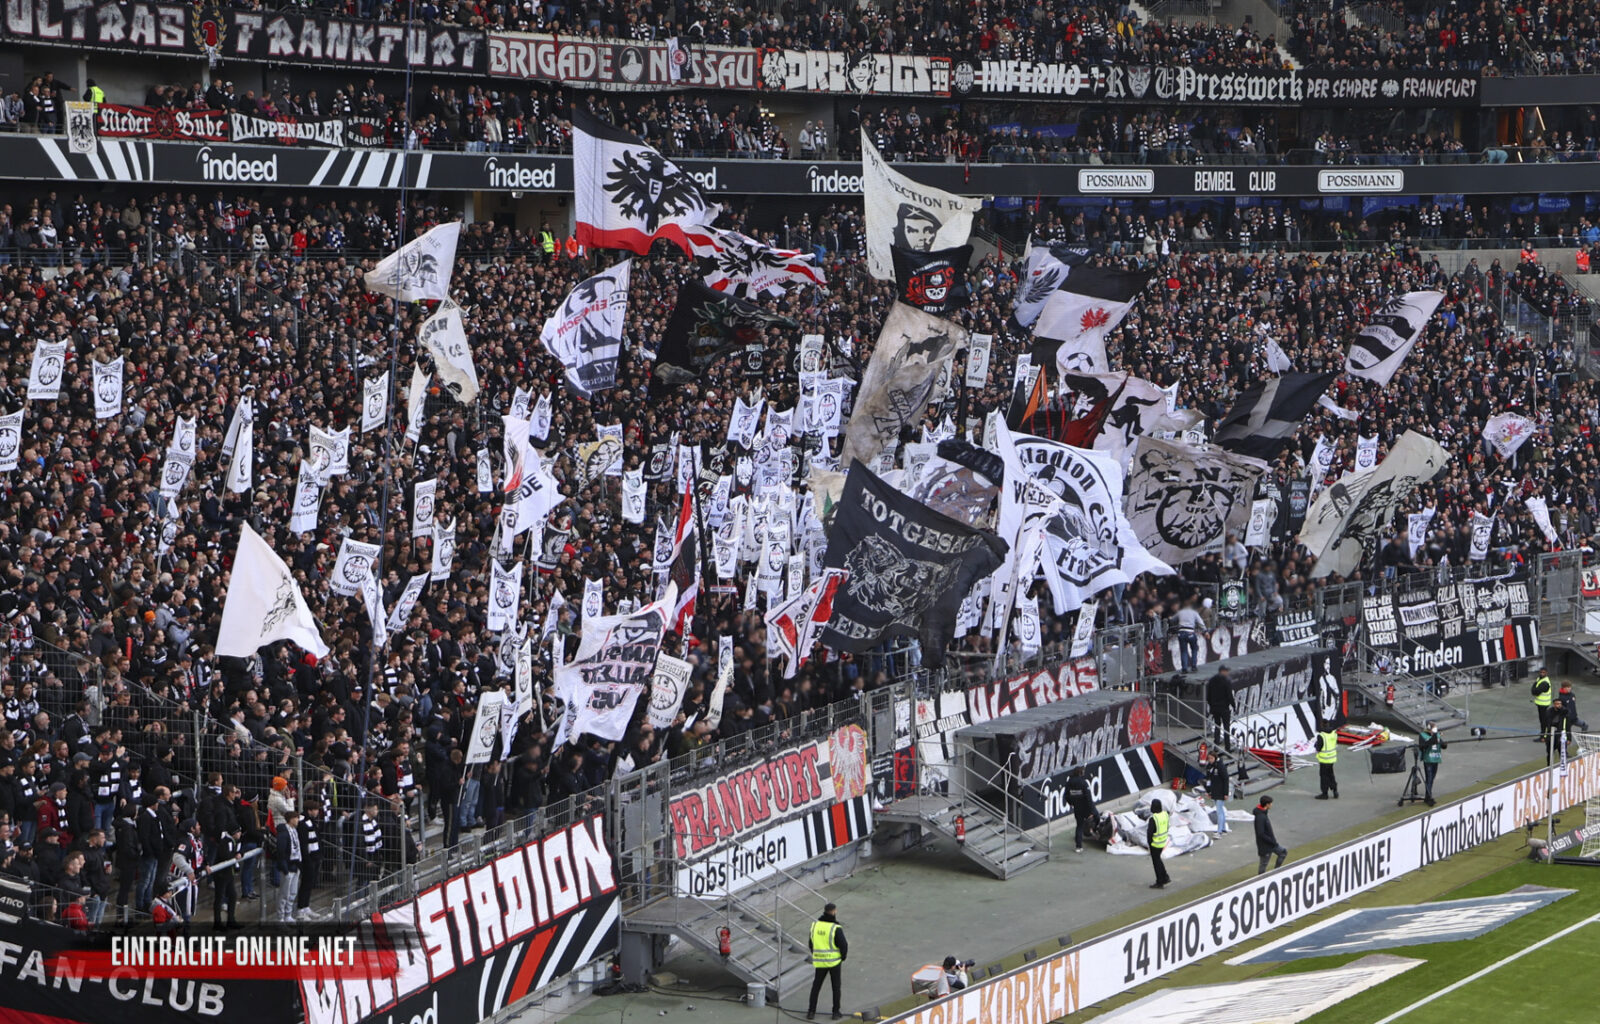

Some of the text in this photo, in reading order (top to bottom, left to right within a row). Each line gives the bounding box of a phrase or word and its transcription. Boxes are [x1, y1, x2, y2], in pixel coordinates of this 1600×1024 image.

[4, 0, 484, 70] ULTRAS FRANKFURT
[488, 38, 755, 88] BRIGADE NSSAU
[981, 59, 1081, 97] INFERNO
[932, 69, 949, 91] 99
[1174, 66, 1305, 101] Presswerk
[1307, 77, 1477, 99] PER SEMPRE FRANKFURT
[101, 108, 224, 138] Nieder Bube
[232, 112, 344, 147] KLIPPENADLER
[202, 152, 277, 182] indeed
[489, 162, 556, 188] indeed
[1086, 174, 1147, 188] POSSMANN
[1195, 171, 1277, 191] BEMBEL CLUB
[1327, 174, 1395, 188] POSSMANN
[1277, 610, 1314, 627] ULTRAS
[1280, 626, 1314, 643] NEVER
[1414, 640, 1463, 672] finden
[968, 658, 1099, 726] ULTRAS
[1017, 708, 1126, 786] Eintracht
[669, 745, 823, 860] FRANKFURT
[1420, 794, 1504, 866] Krombacher
[732, 833, 787, 881] finden
[1122, 931, 1150, 984] 14
[1156, 912, 1205, 970] MIO.
[1210, 901, 1224, 947] €
[1227, 837, 1392, 941] SOFORTGEWINNE!
